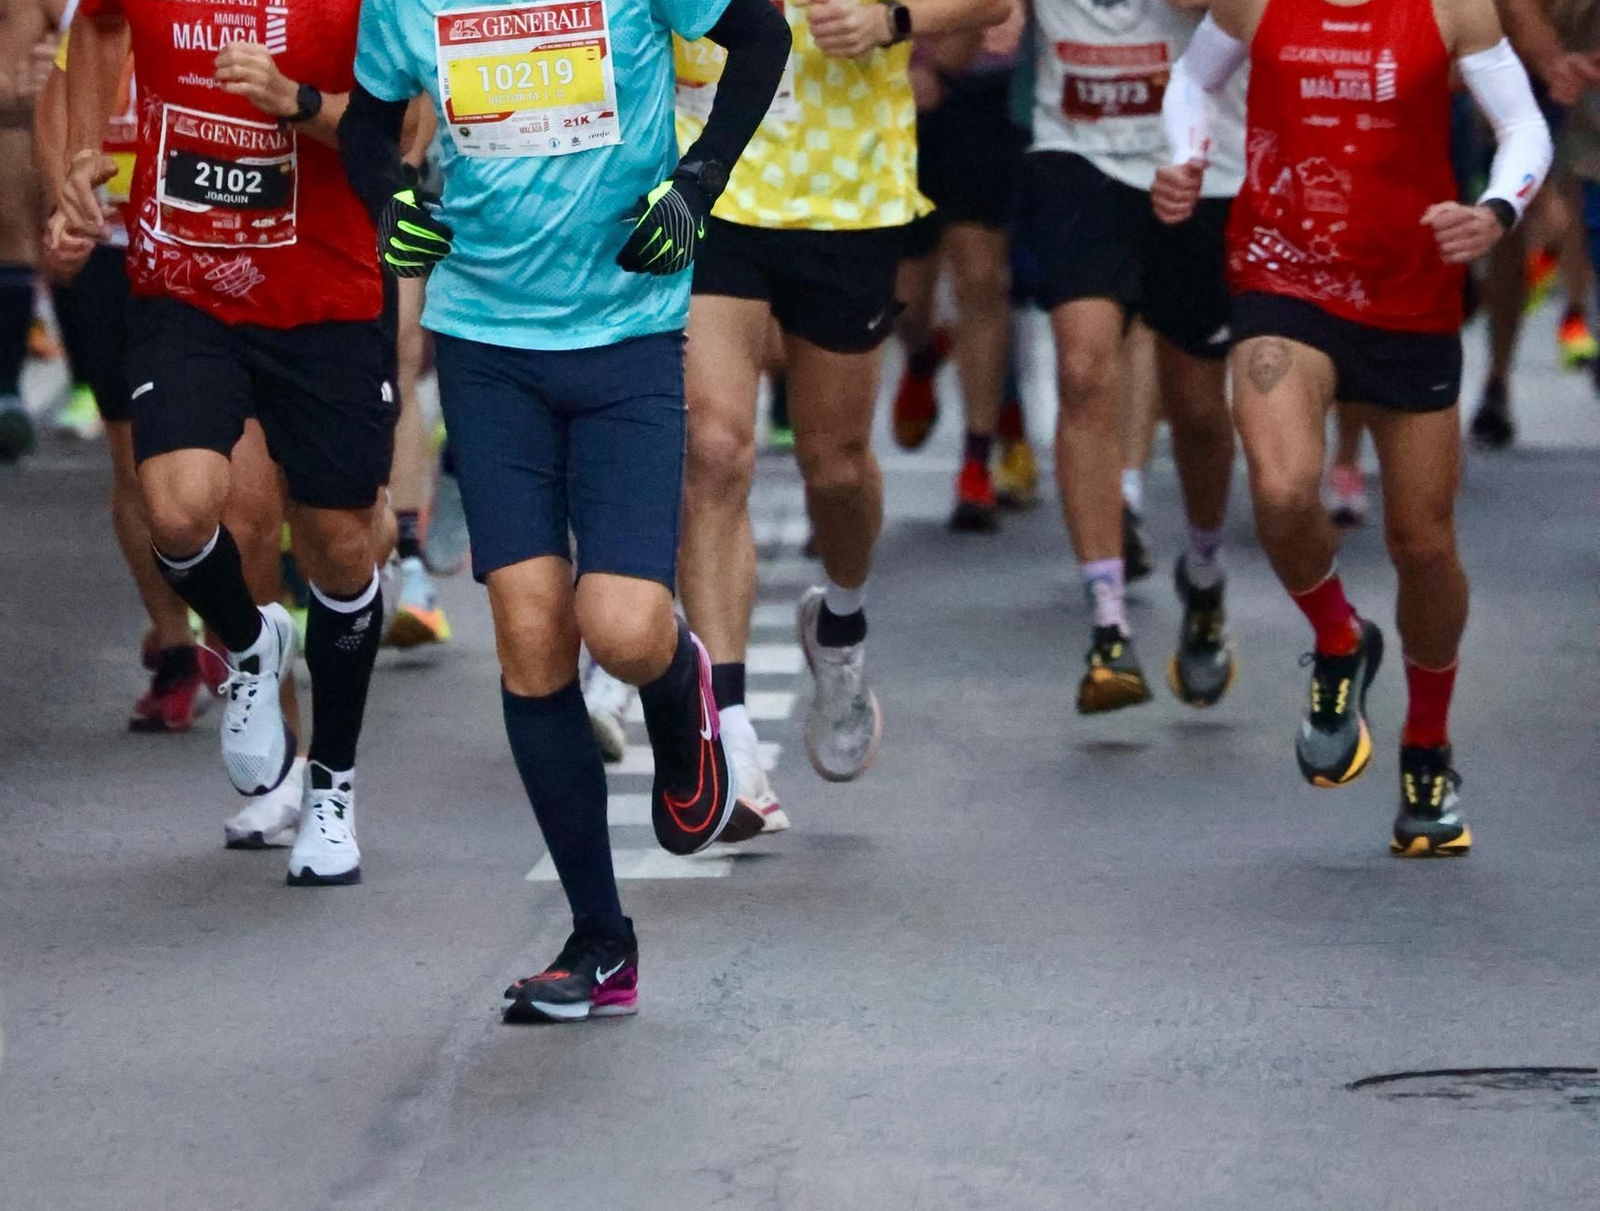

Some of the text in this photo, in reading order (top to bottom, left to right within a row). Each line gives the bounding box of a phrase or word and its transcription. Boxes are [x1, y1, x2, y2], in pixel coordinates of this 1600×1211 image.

[482, 7, 592, 37] GENERALI
[477, 58, 574, 92] 10219
[563, 115, 591, 128] 21K
[194, 161, 262, 193] 2102
[205, 191, 249, 204] JOAQUIN
